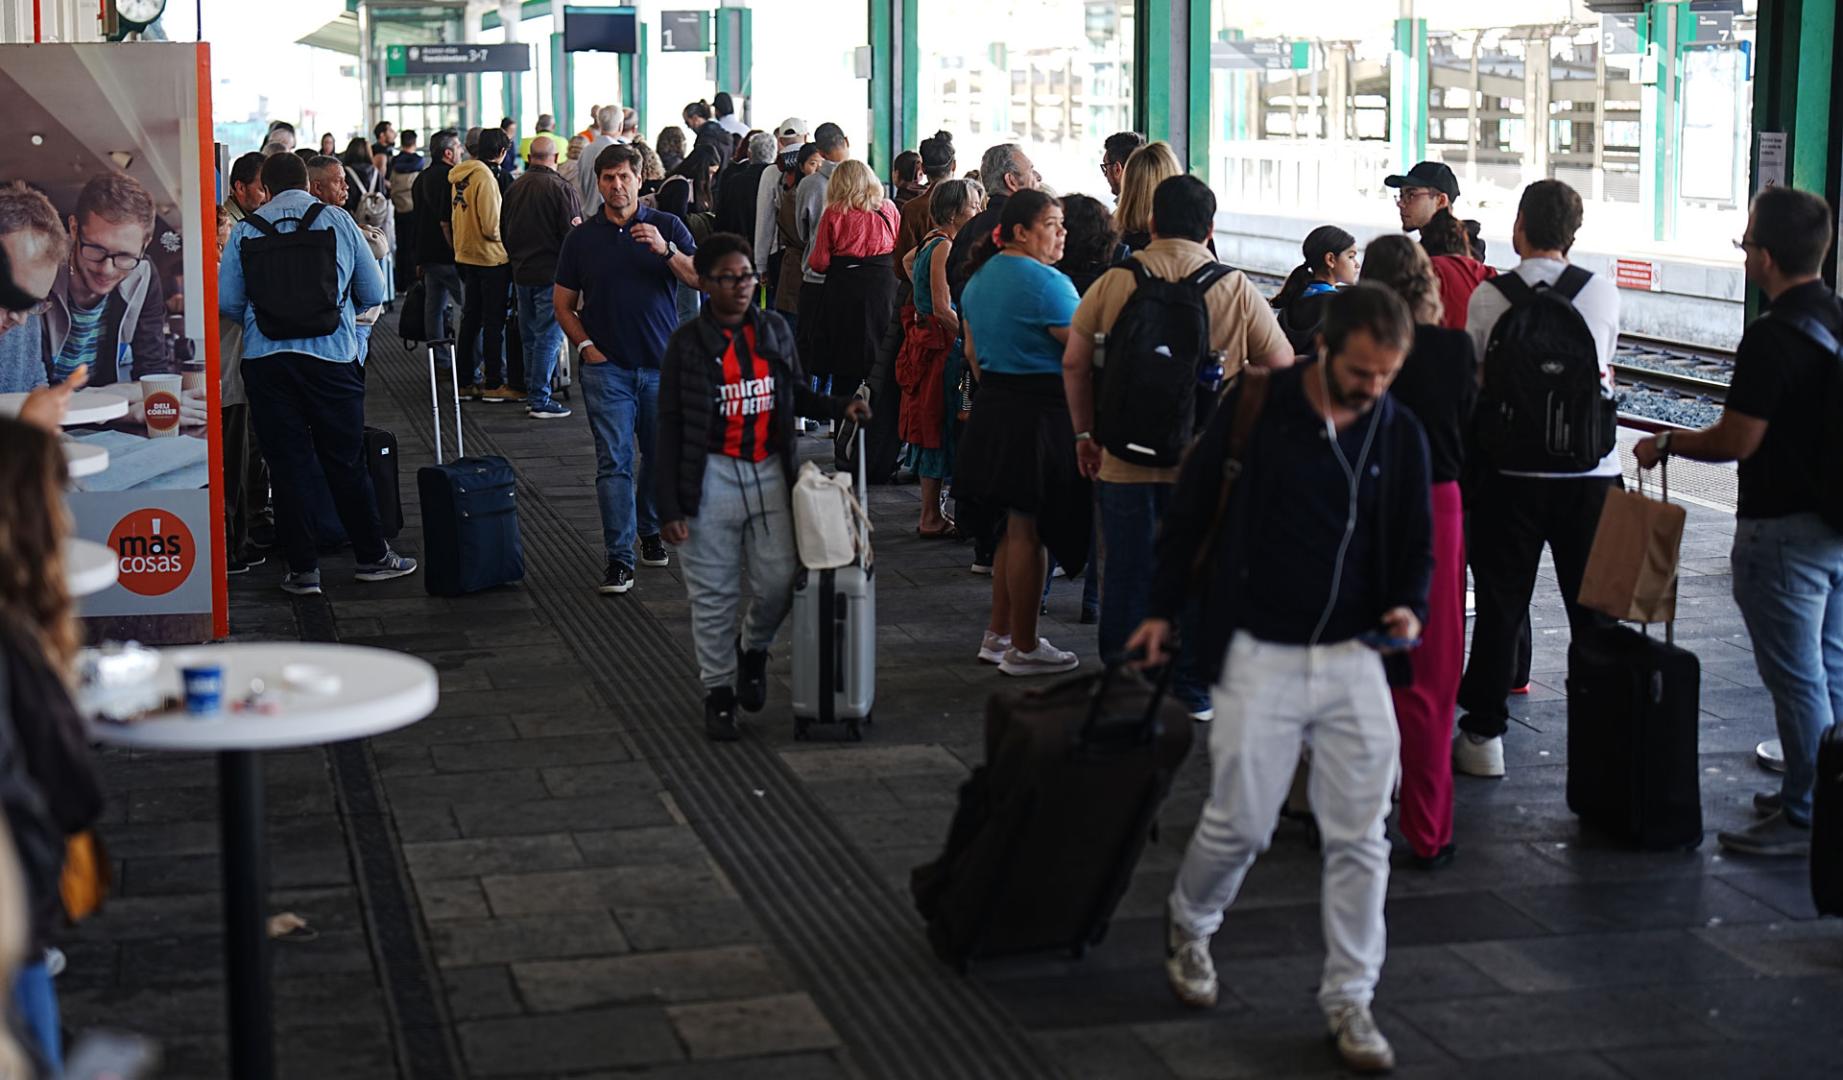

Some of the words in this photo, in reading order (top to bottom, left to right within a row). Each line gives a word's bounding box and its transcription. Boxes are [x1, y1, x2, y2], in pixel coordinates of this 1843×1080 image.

[663, 29, 676, 50] 1
[1603, 32, 1615, 53] 3
[119, 555, 182, 573] cosas
